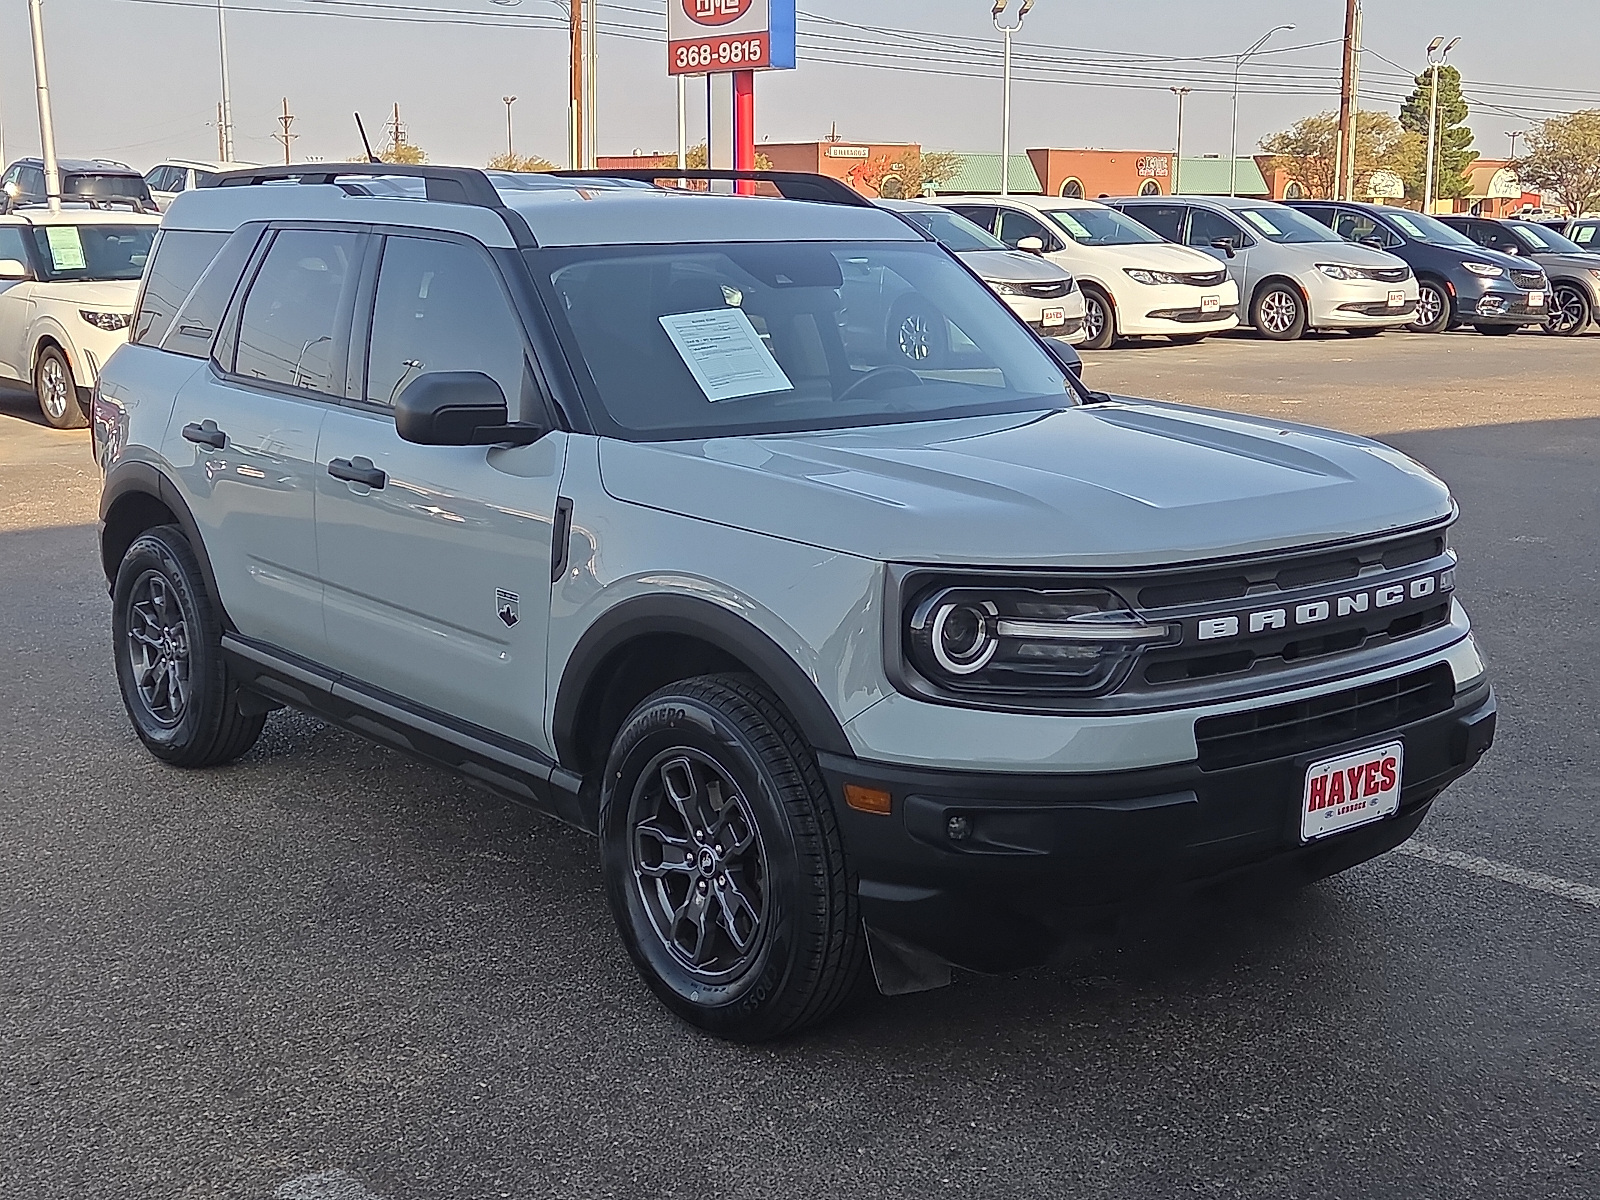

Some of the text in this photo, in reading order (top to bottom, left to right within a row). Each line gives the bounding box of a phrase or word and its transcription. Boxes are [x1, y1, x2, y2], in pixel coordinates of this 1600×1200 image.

[676, 39, 762, 67] 368-9815
[1198, 577, 1435, 640] BRONCO
[1307, 757, 1398, 813] HAYES
